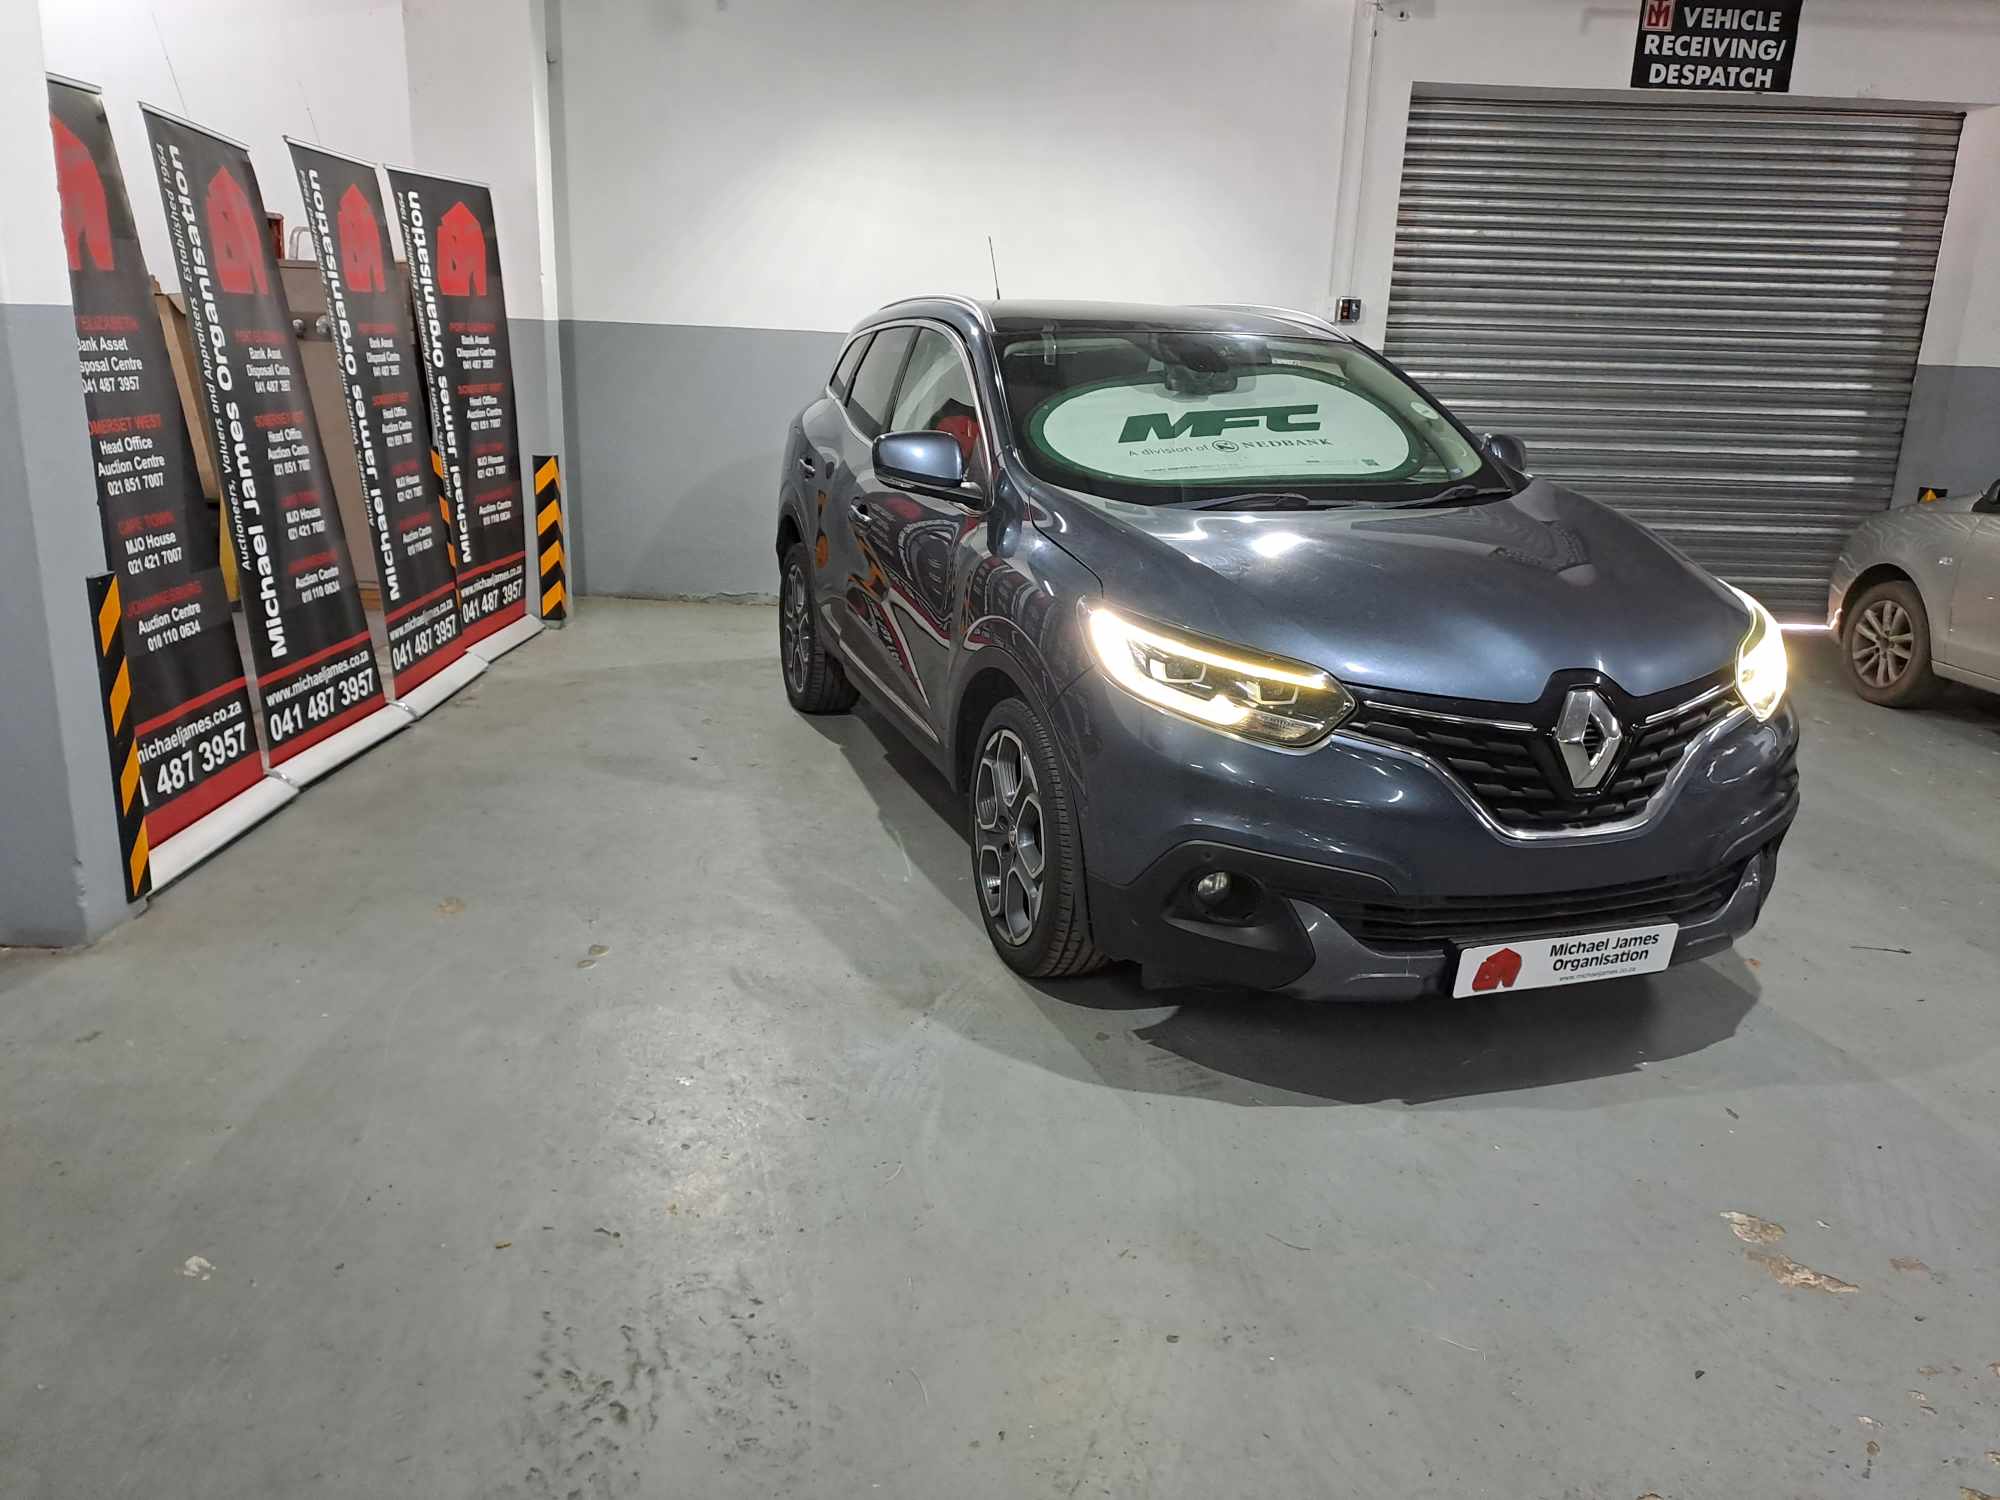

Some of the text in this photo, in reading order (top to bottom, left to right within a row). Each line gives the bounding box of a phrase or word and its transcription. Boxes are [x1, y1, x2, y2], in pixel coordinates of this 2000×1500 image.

[1684, 7, 1782, 32] VEHICLE
[1644, 34, 1786, 61] RECEIVING/
[1649, 63, 1773, 89] DESPATCH
[156, 143, 172, 188] 1964
[166, 188, 193, 284] Established
[100, 337, 128, 351] Asset
[190, 295, 214, 381] Appraisers
[80, 356, 143, 375] sposal Centre
[408, 191, 472, 563] Michael James Organisation
[82, 376, 139, 393] 041 487 3957
[206, 383, 220, 414] and
[308, 169, 400, 601] Michael James Organisation
[169, 145, 288, 658] Michael James Organisation
[1118, 404, 1320, 444] MFC
[99, 435, 153, 455] Head Office
[215, 417, 232, 475] Valuers
[1142, 446, 1193, 456] division
[1242, 438, 1333, 449] NEDBANK
[98, 455, 165, 477] Auction Centre
[107, 472, 164, 496] 021 851 7007
[228, 479, 251, 571] Auctioneers,
[125, 532, 177, 555] MJO House
[128, 547, 183, 575] 021 421 7007
[462, 578, 522, 624] 041 487 3957
[138, 602, 201, 635] Auction Centre
[163, 628, 178, 646] 110
[392, 613, 456, 671] 041 487 3957
[266, 650, 369, 707] www.michaeljames.co.za
[270, 667, 374, 741] 041 487 3957
[137, 701, 242, 765] michaeljames.co.za
[157, 750, 194, 794] 487
[198, 722, 246, 772] 3957
[1549, 934, 1660, 957] Michael James
[1553, 949, 1649, 971] Organisation
